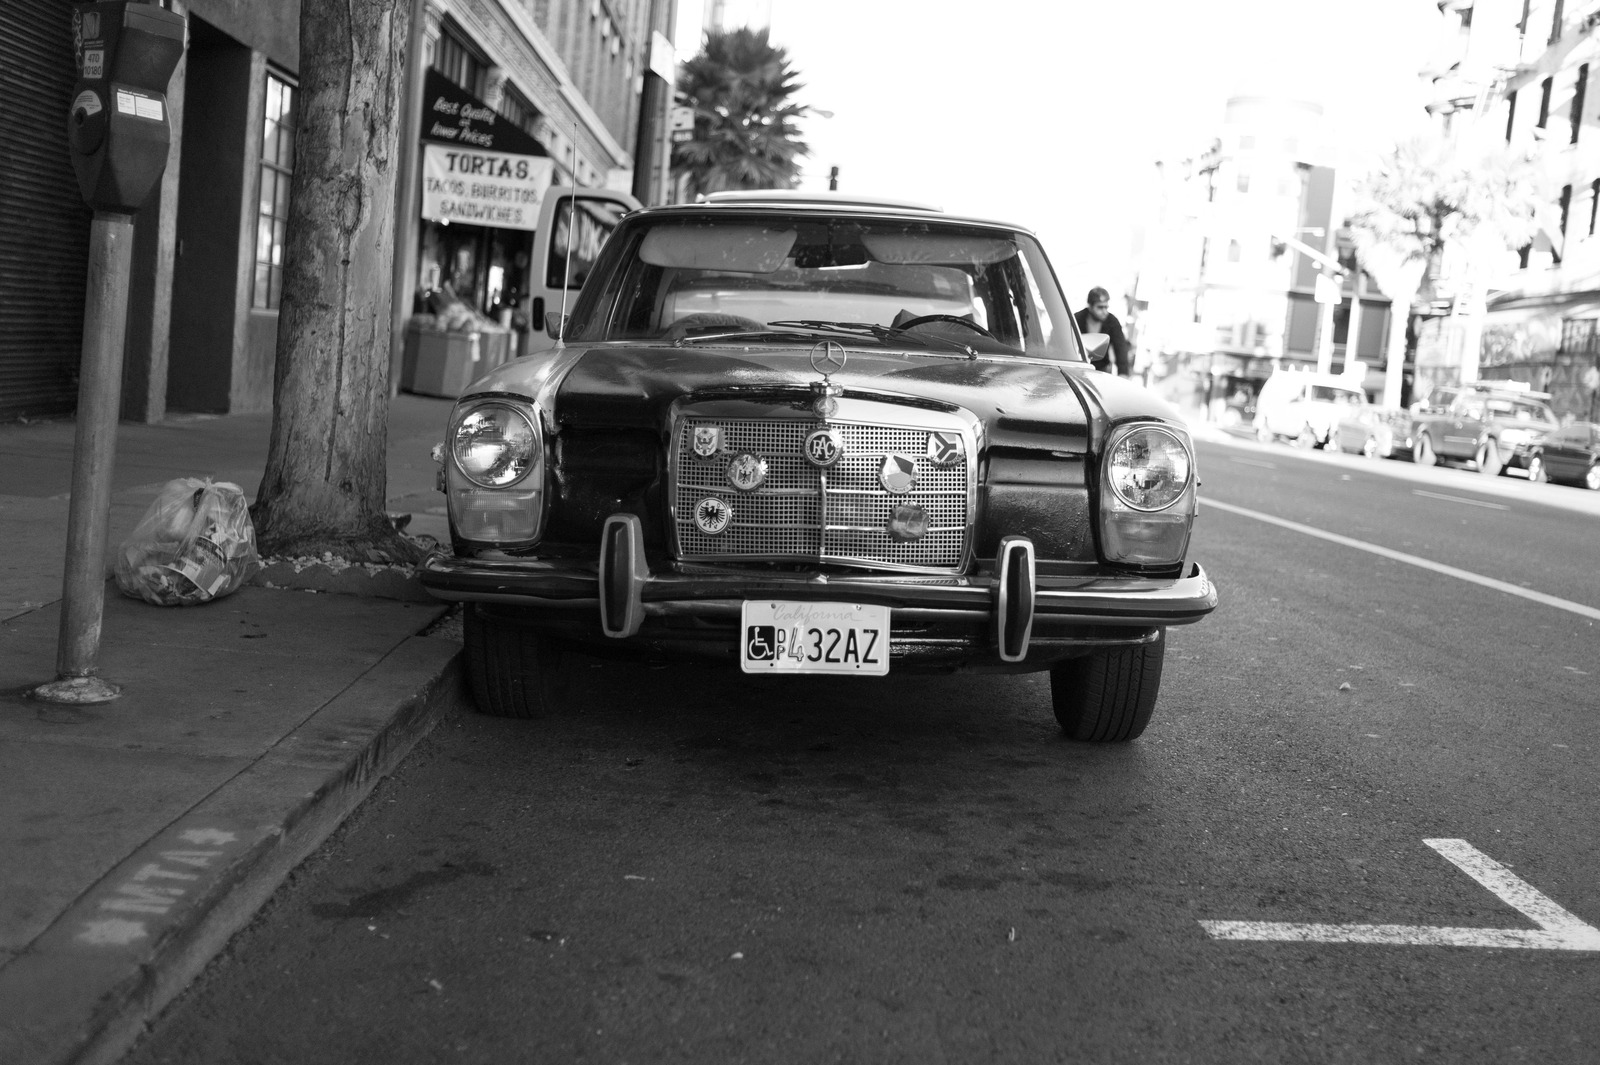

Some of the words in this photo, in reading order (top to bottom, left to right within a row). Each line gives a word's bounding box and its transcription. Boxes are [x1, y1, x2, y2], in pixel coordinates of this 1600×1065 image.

[88, 53, 100, 63] 470
[84, 66, 102, 75] 10180
[433, 96, 460, 115] Best
[460, 103, 496, 126] Quality
[459, 126, 494, 147] Prices
[812, 436, 834, 459] RAC
[773, 604, 863, 624] California
[788, 627, 879, 664] 432AZ
